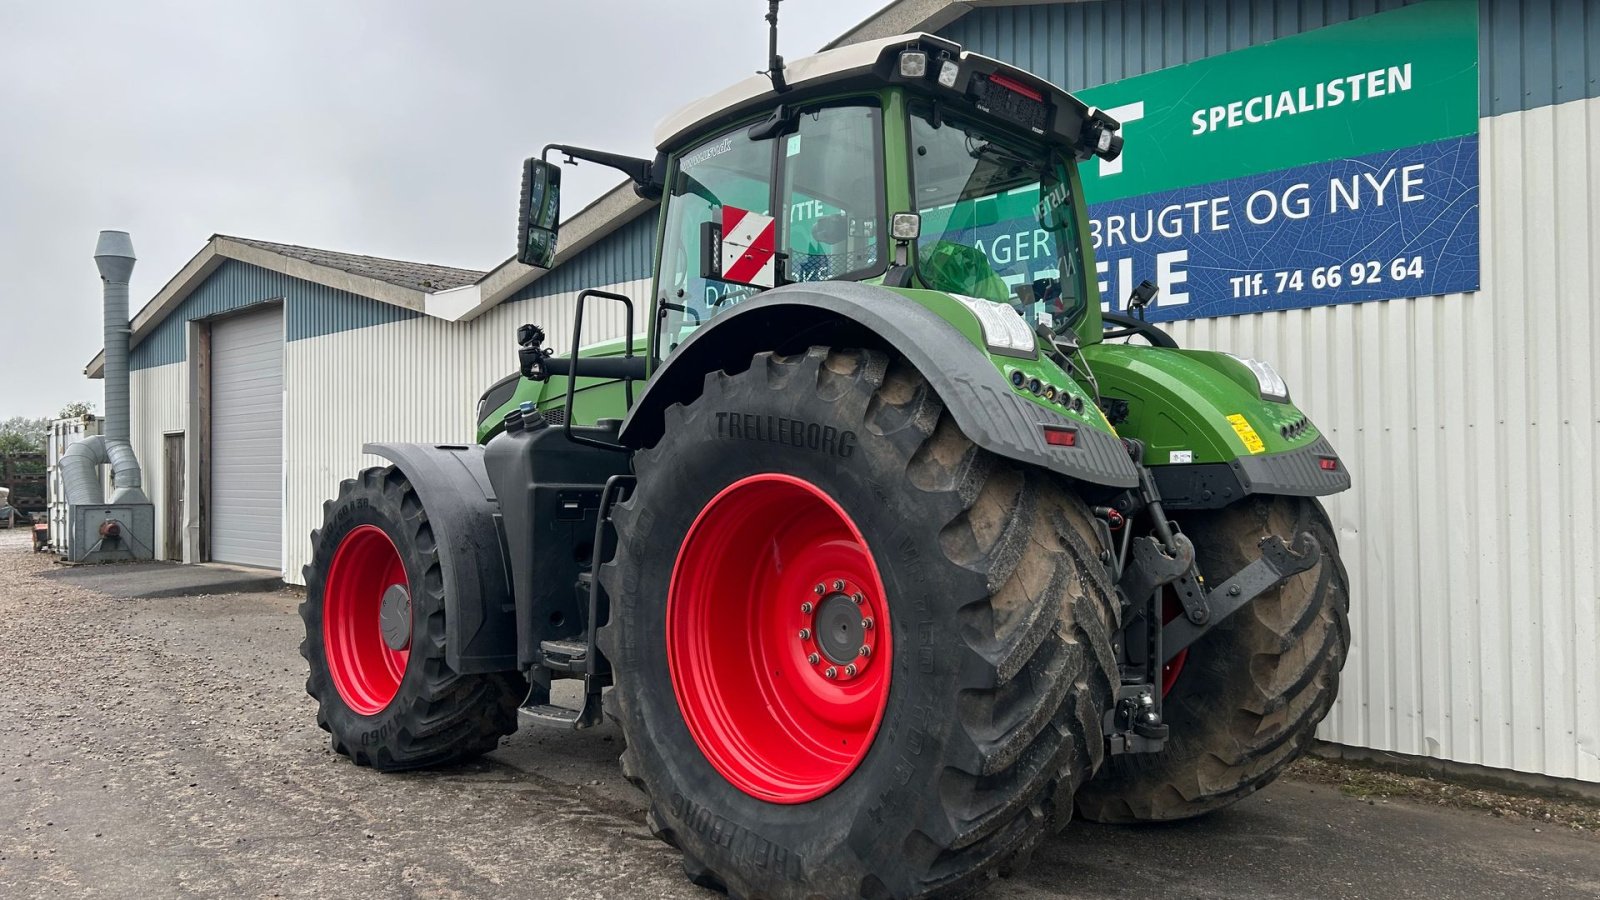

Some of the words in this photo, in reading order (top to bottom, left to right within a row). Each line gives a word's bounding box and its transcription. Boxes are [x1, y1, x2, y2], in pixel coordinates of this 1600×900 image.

[1192, 62, 1412, 135] SPECIALISTEN
[1246, 182, 1310, 225] OG
[1330, 163, 1425, 214] NYE
[1230, 272, 1268, 298] Tlf.
[1275, 269, 1304, 294] 74
[1311, 265, 1342, 289] 66
[1350, 260, 1382, 286] 92
[1390, 255, 1425, 282] 64
[715, 411, 858, 458] TRELLEBORG
